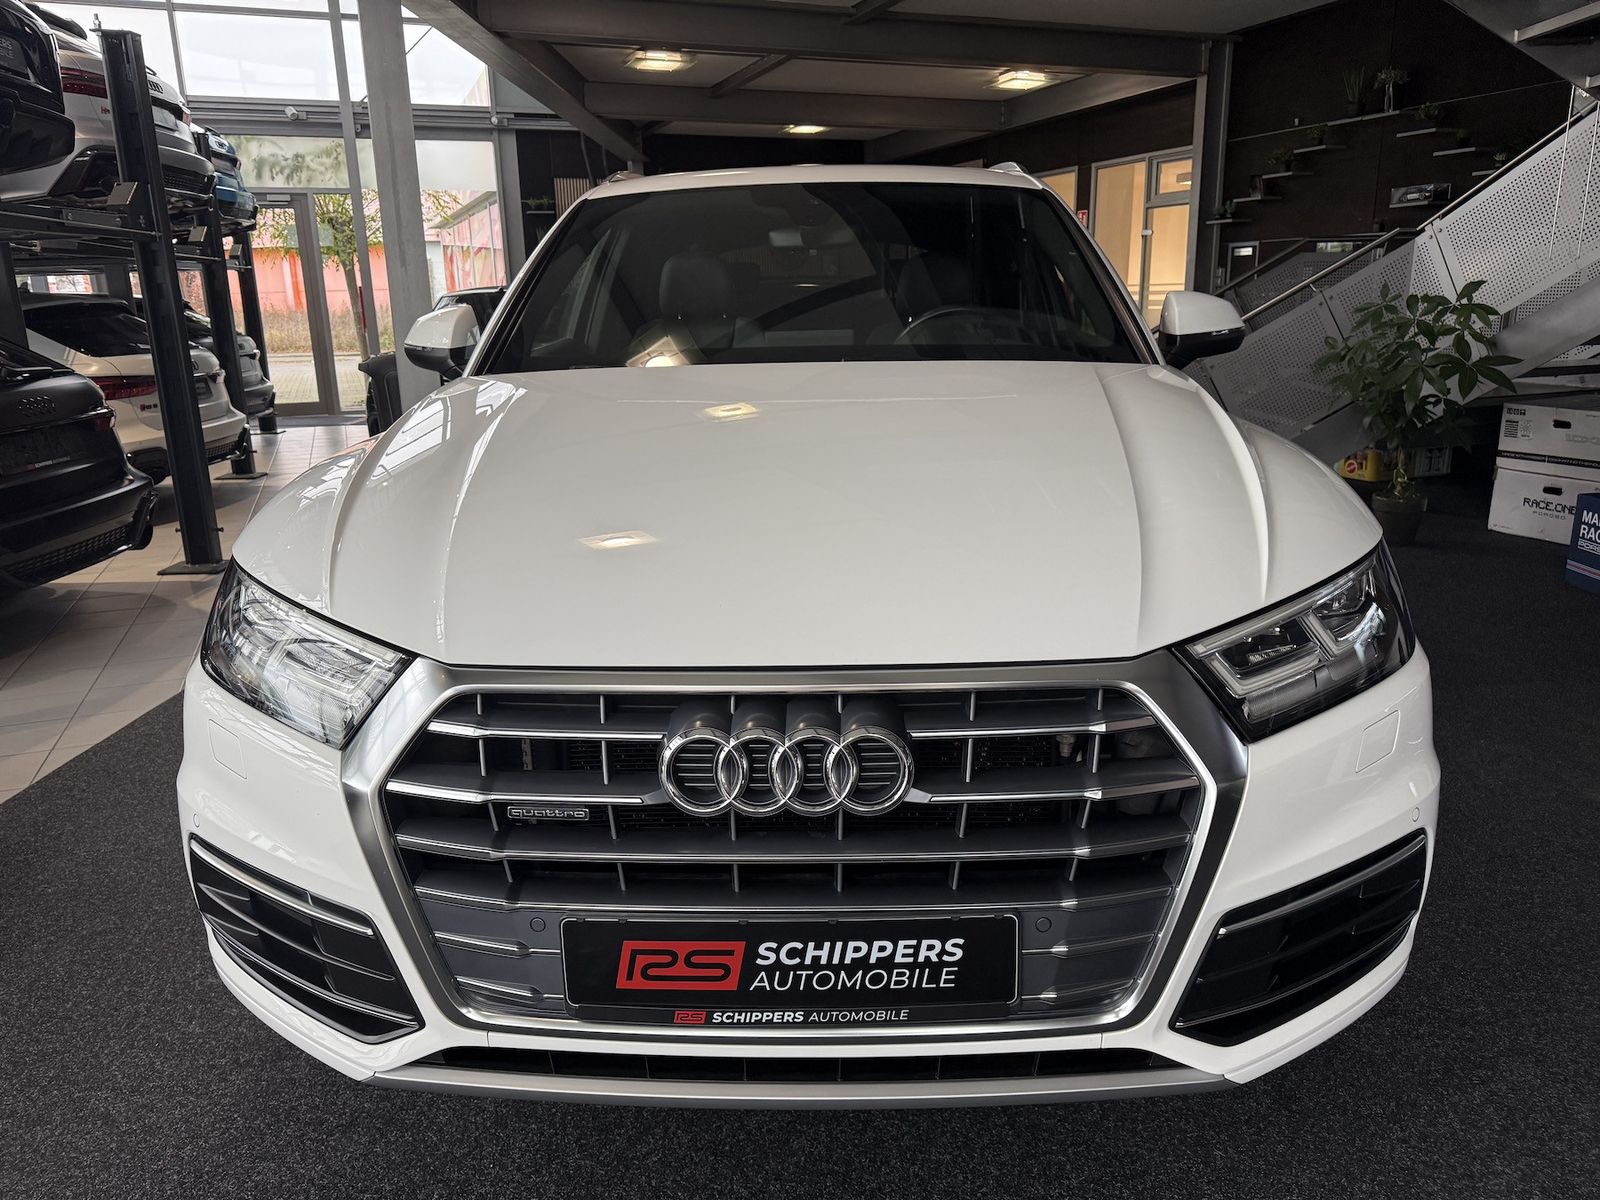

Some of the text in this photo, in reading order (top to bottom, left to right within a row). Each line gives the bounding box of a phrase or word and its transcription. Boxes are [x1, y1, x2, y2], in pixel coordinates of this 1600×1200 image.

[510, 808, 587, 819] quattro
[756, 938, 965, 965] SCHIPPERS
[750, 967, 959, 992] AUTOMOBILE
[712, 1011, 804, 1024] SCHIPPERS
[808, 1009, 910, 1023] AUTOMOBILE
